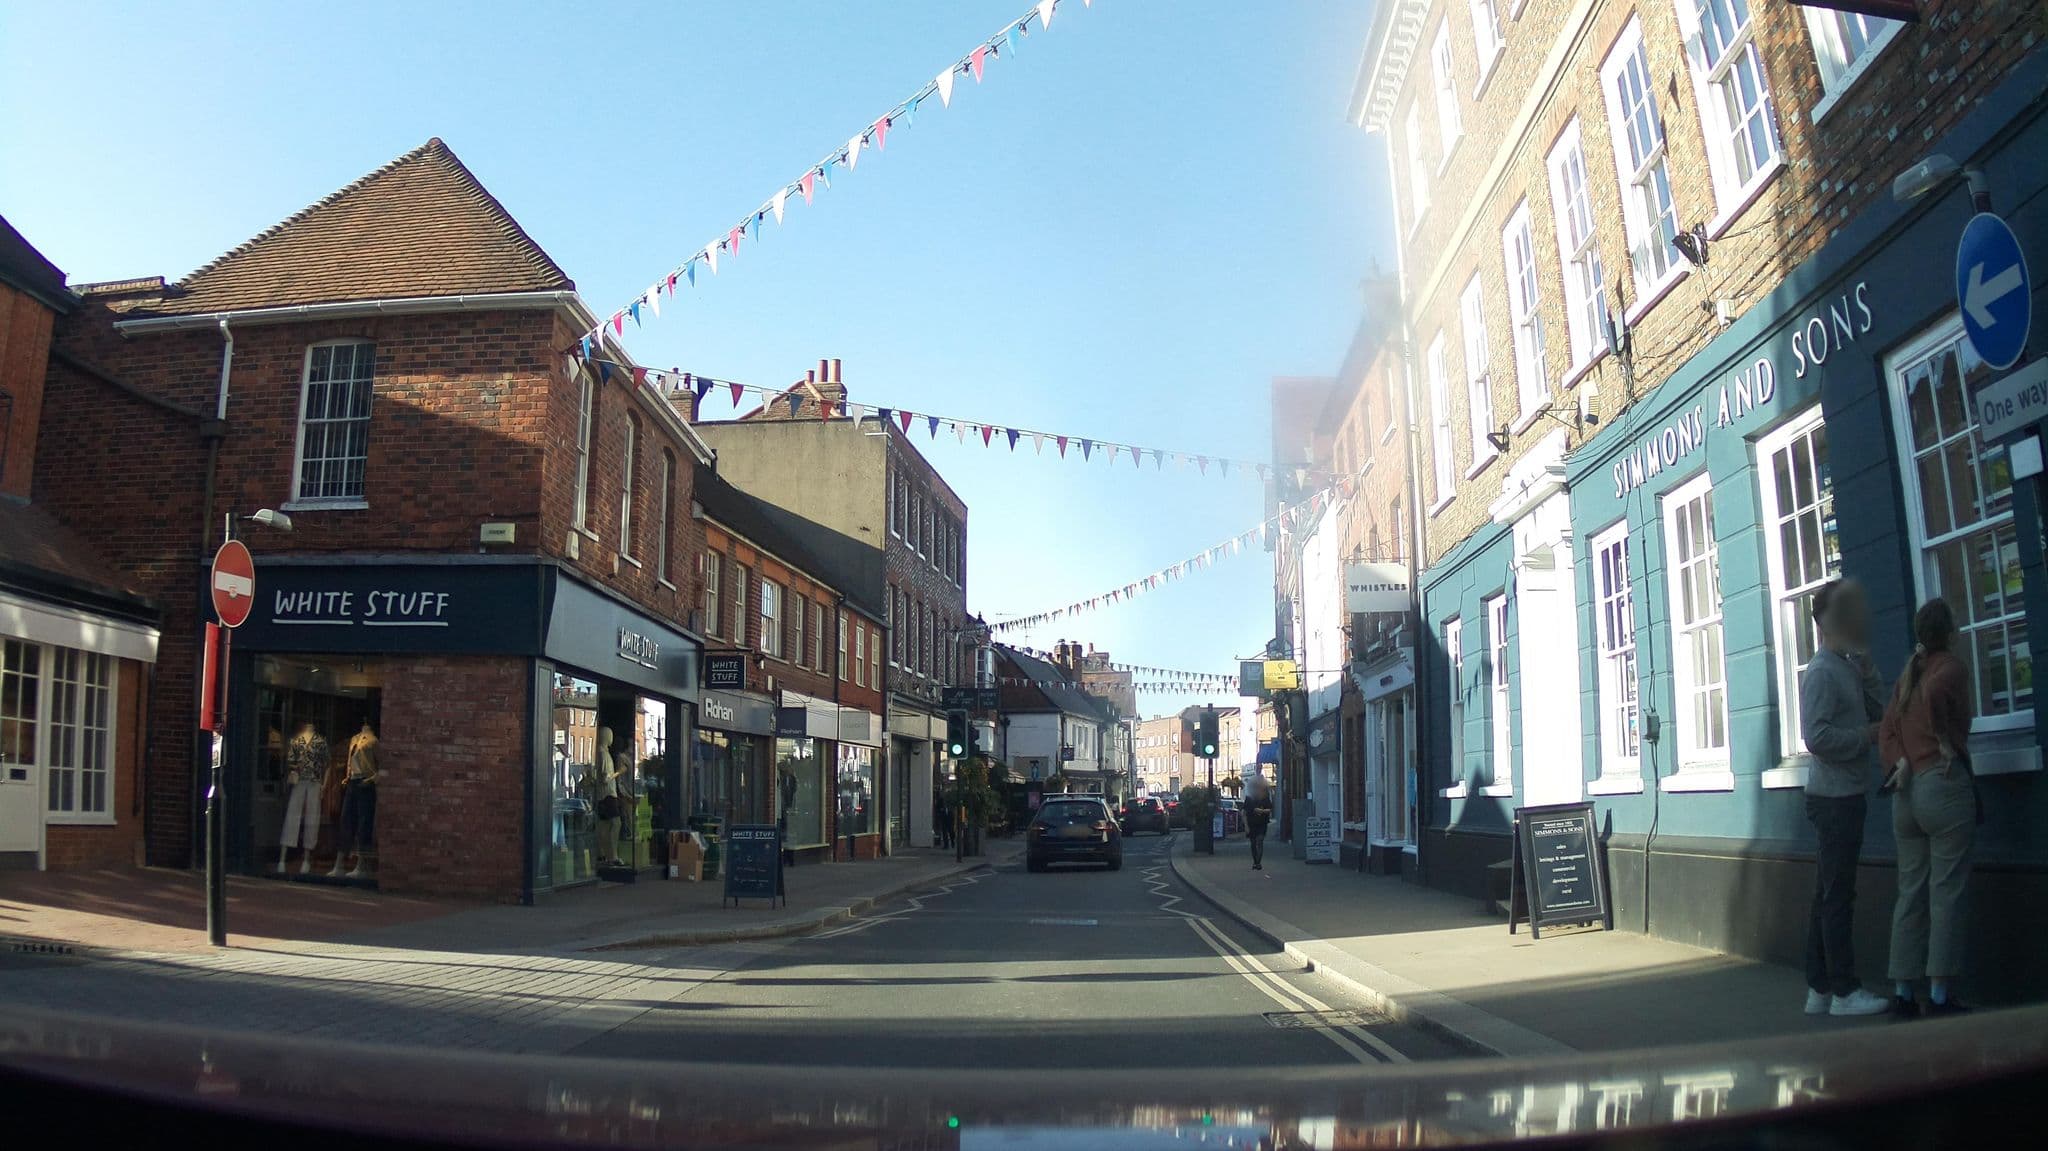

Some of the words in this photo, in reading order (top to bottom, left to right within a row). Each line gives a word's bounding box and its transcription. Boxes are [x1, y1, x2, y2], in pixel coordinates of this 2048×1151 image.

[1612, 403, 1704, 499] SIMMONS
[1717, 356, 1776, 430] AND
[1791, 280, 1875, 379] SONS
[1984, 397, 2014, 425] One
[2017, 379, 2048, 409] way
[1350, 583, 1407, 592] WHISTLES
[273, 589, 353, 617] WHITE
[363, 590, 450, 618] STUFF
[620, 626, 641, 655] WHITE
[641, 635, 660, 662] STUFF
[711, 660, 739, 670] WHITE
[711, 672, 739, 682] STUFF
[705, 697, 734, 722] Rohan
